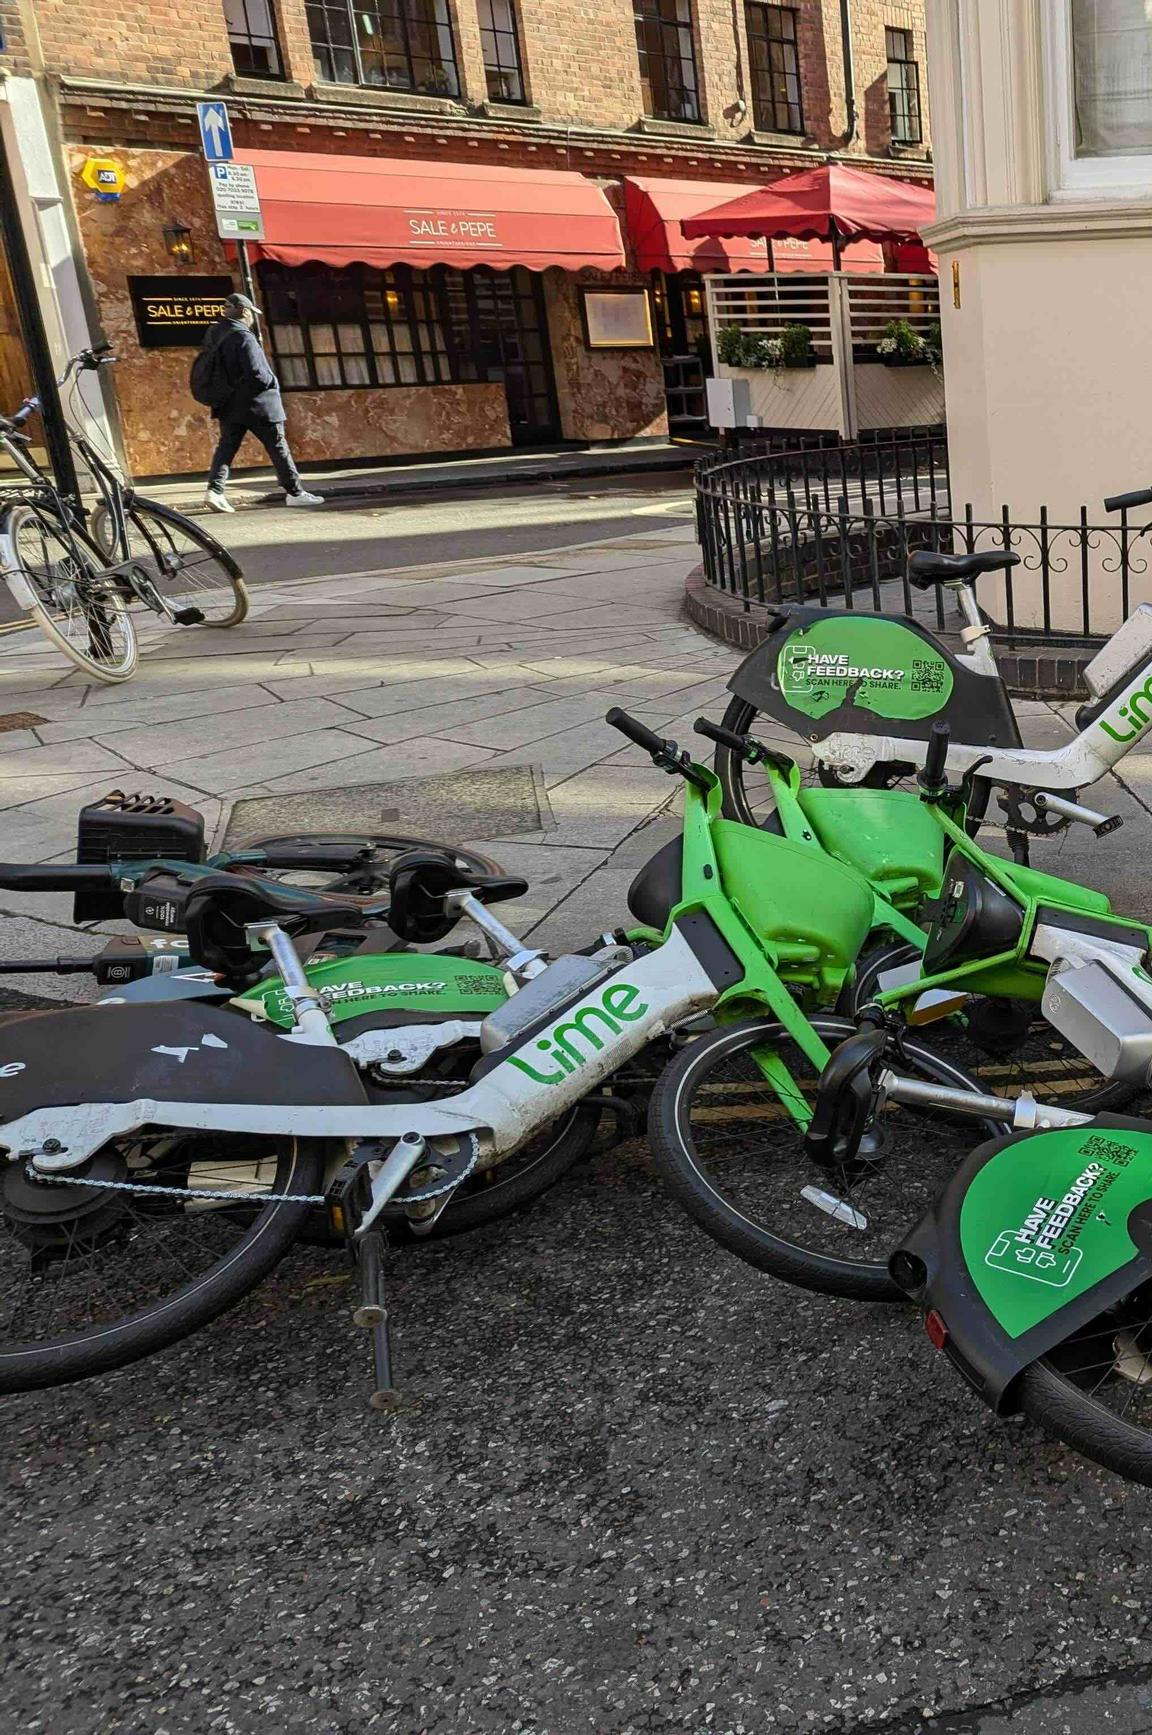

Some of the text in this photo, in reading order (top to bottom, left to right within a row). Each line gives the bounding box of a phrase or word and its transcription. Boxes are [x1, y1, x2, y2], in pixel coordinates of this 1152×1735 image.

[99, 171, 116, 182] ADT
[217, 167, 225, 178] P
[409, 219, 448, 236] SALE
[458, 221, 497, 238] PEPE
[147, 305, 184, 318] SALE
[807, 654, 850, 666] HAVE
[806, 665, 905, 681] FEEDBACK?
[805, 678, 831, 687] SCAN
[869, 680, 902, 690] SHARE.
[319, 980, 363, 995] AVE
[322, 981, 448, 1001] EEDBACK?
[1035, 1162, 1106, 1250] FEEDBACK?
[1014, 1197, 1057, 1244] HAVE
[1058, 1224, 1082, 1256] SCAN
[1078, 1199, 1097, 1227] HERE
[1091, 1189, 1104, 1203] TO
